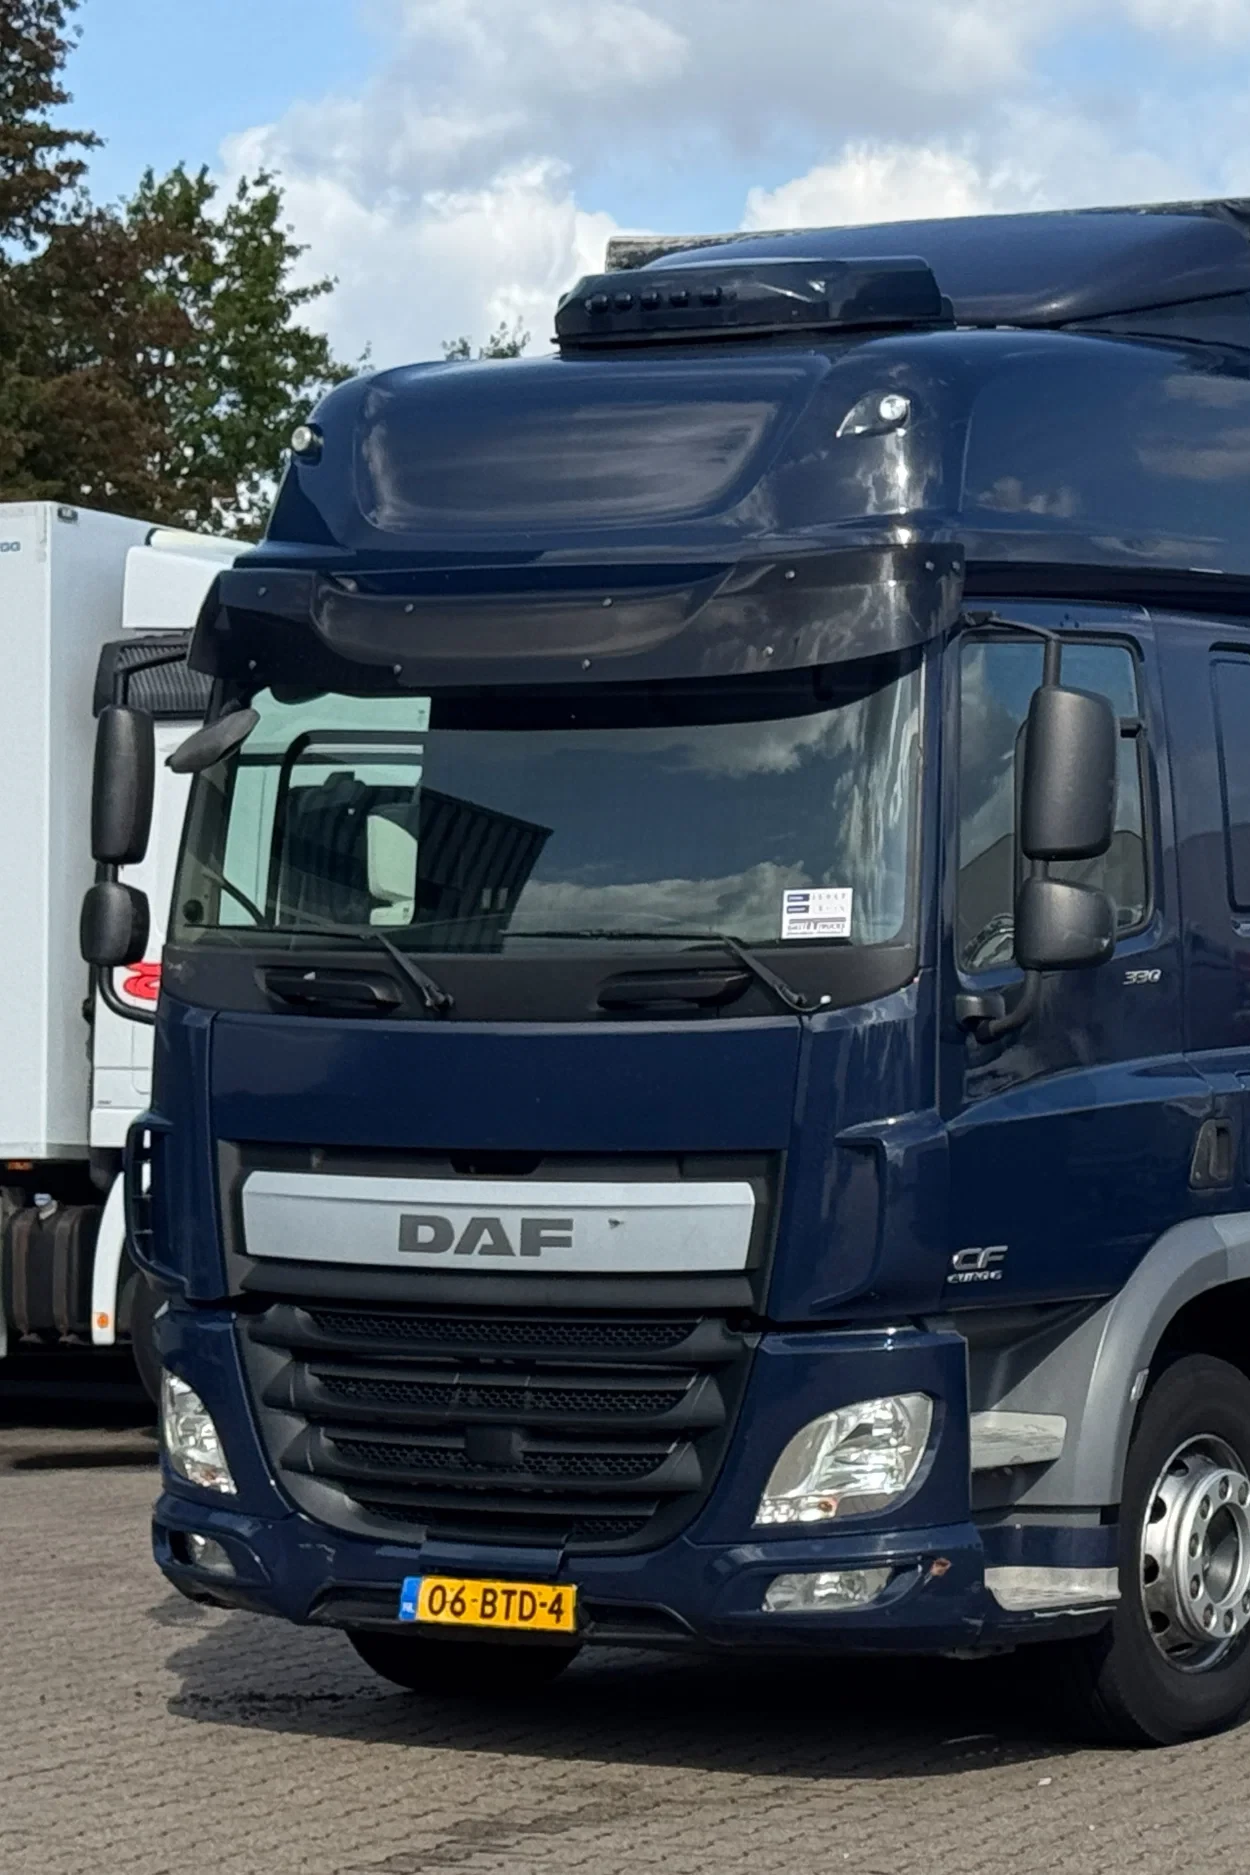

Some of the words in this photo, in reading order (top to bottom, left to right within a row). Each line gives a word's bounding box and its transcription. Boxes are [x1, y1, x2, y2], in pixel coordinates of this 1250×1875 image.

[398, 1213, 574, 1257] DAF
[952, 1245, 1009, 1271] CF
[427, 1584, 564, 1624] 06-BTD-4
